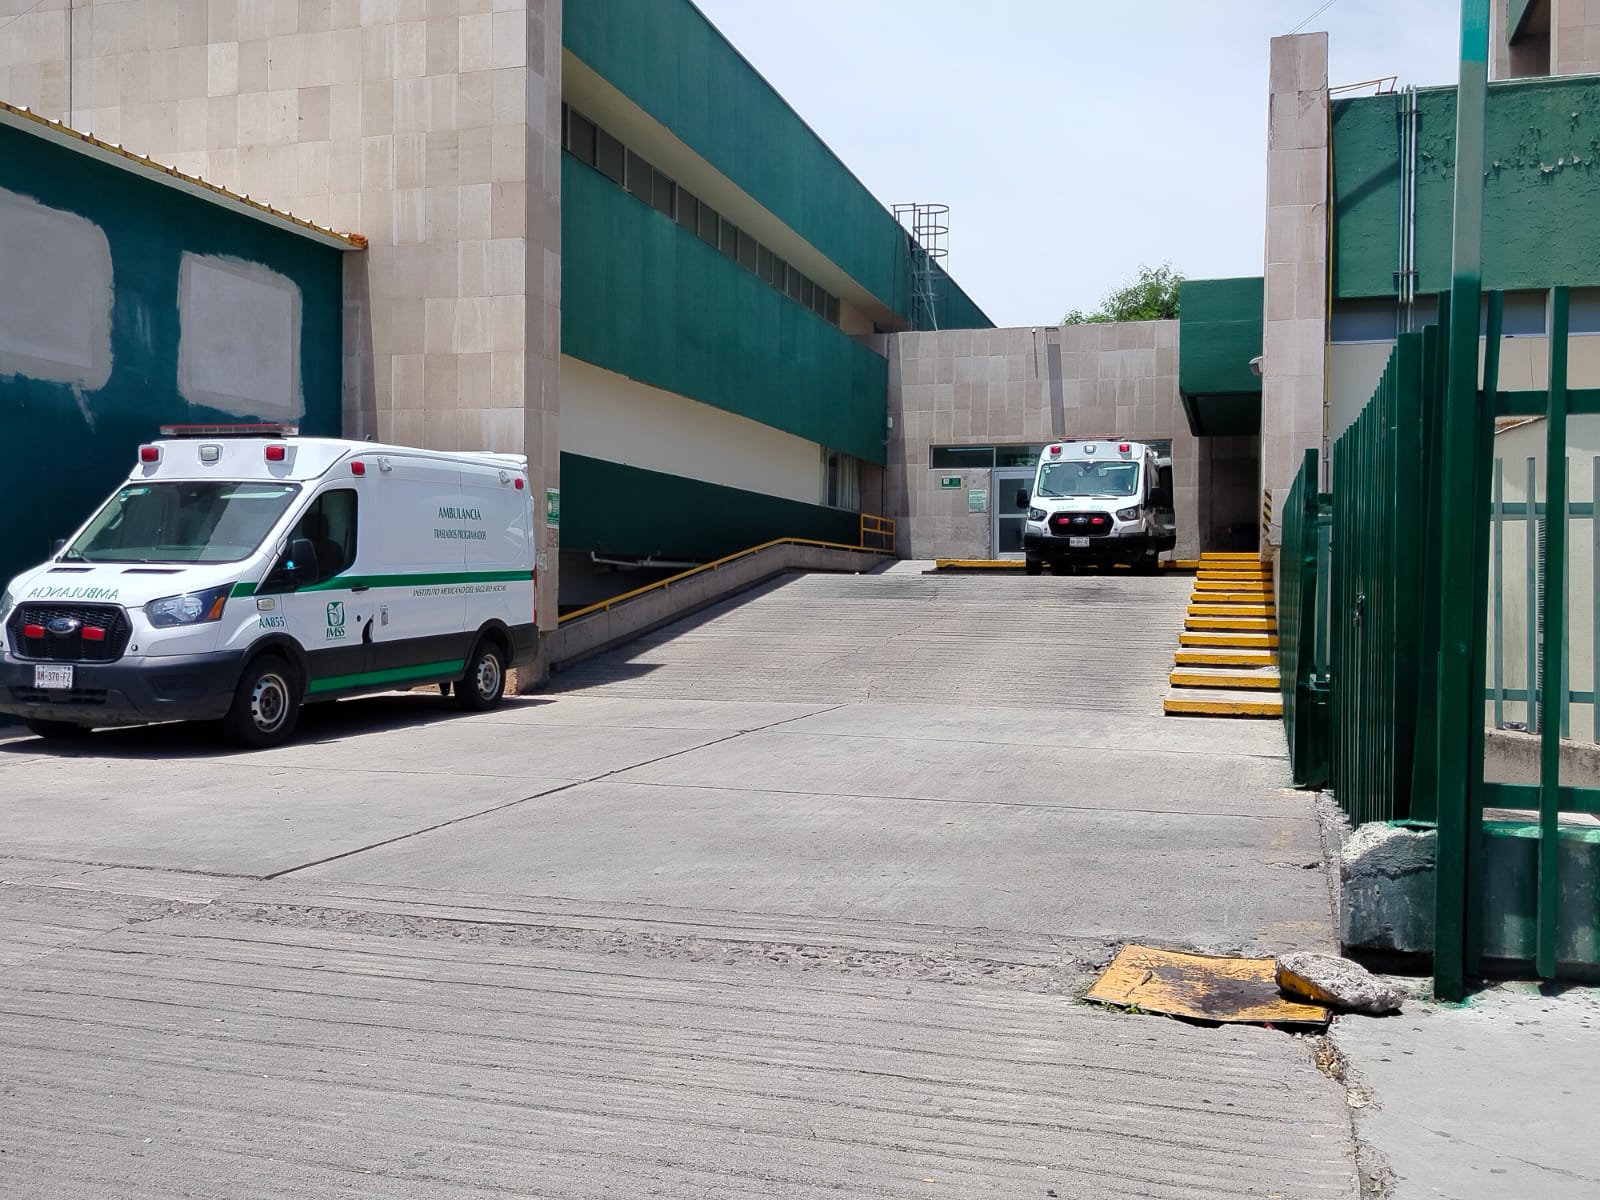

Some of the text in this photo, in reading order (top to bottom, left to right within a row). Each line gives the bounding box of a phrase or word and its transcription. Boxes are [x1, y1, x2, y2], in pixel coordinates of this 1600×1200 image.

[438, 506, 482, 520] AMBULANCIA
[259, 616, 285, 628] AA855
[326, 626, 345, 638] IMSS
